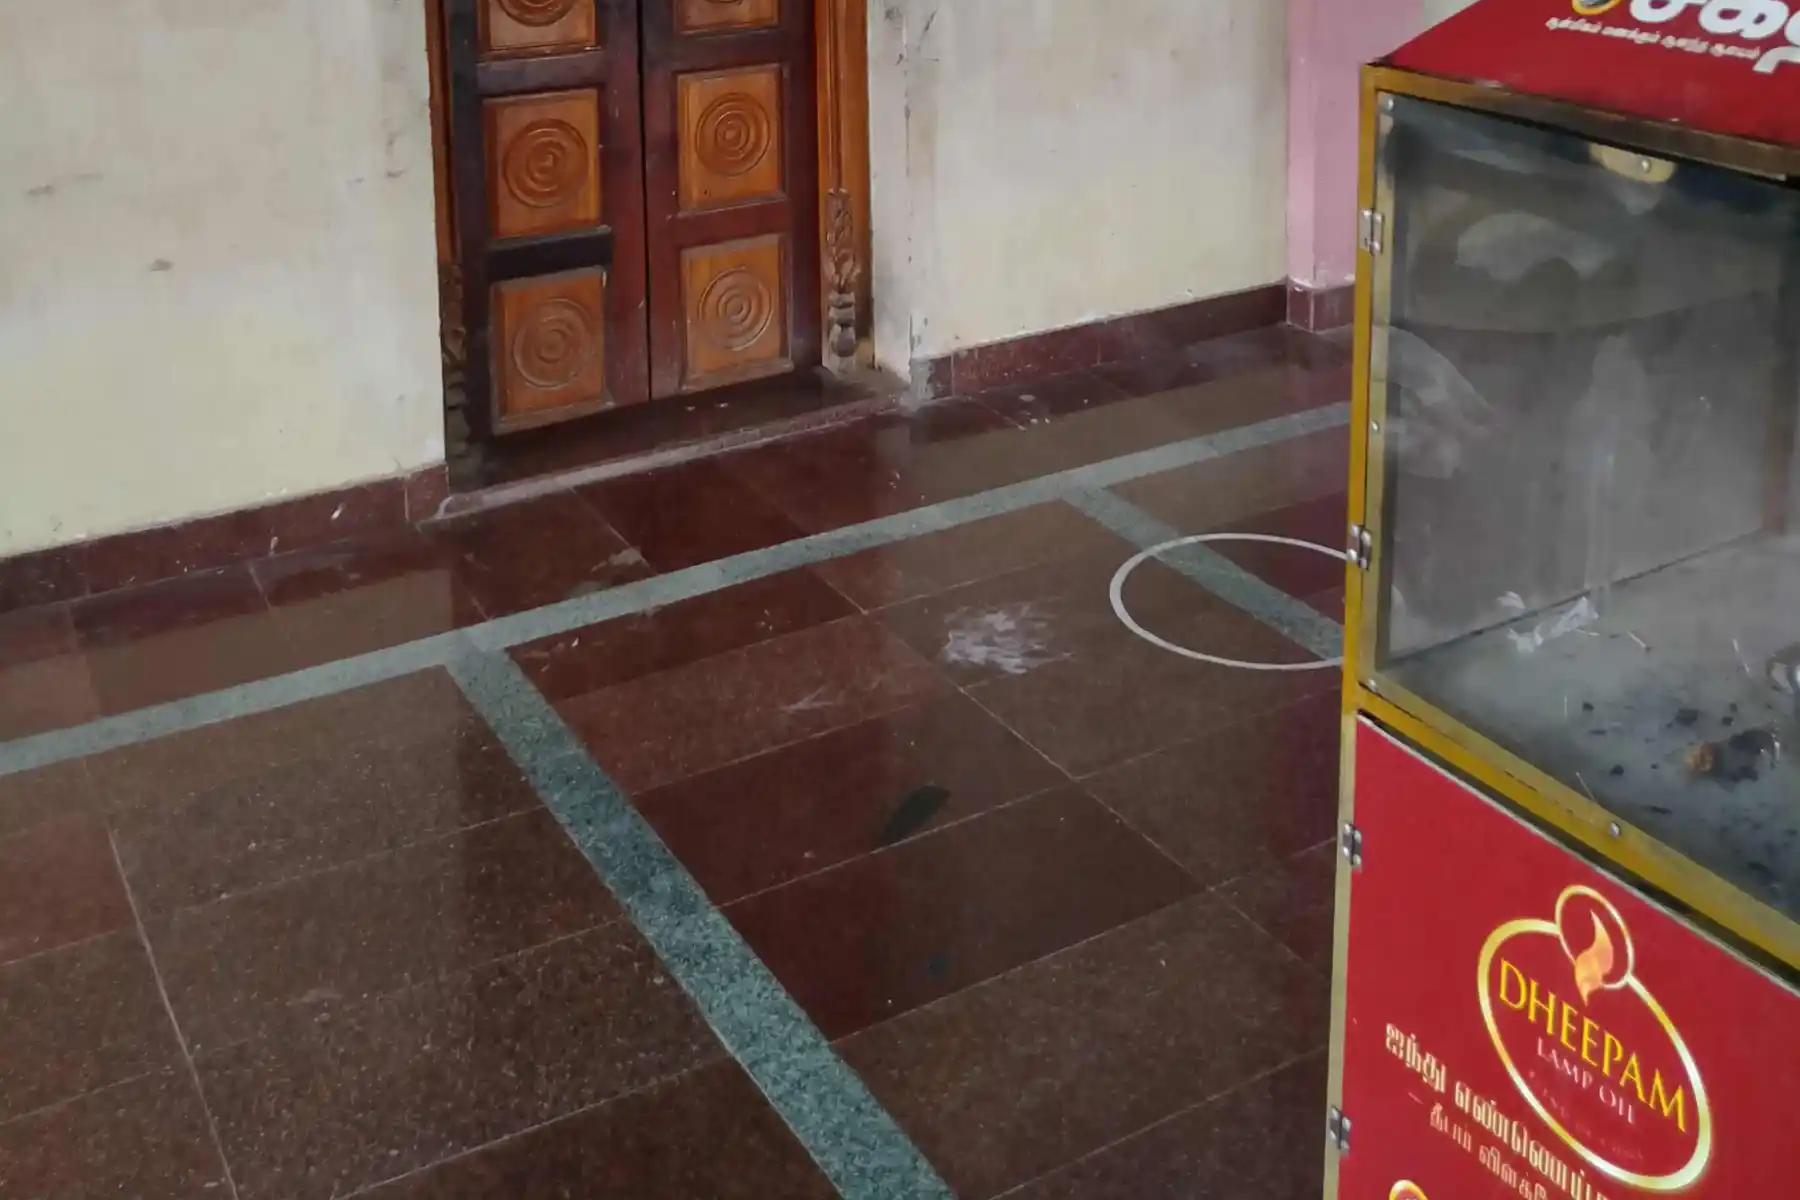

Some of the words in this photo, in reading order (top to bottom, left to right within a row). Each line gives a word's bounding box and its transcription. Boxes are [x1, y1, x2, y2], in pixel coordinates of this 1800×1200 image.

[1386, 1022, 1447, 1094] ஐந்து
[1455, 1080, 1609, 1200] எண்ணெய்
[1498, 958, 1687, 1133] DHEEPAM
[1536, 1036, 1593, 1089] LAMP
[1598, 1085, 1635, 1124] OIL
